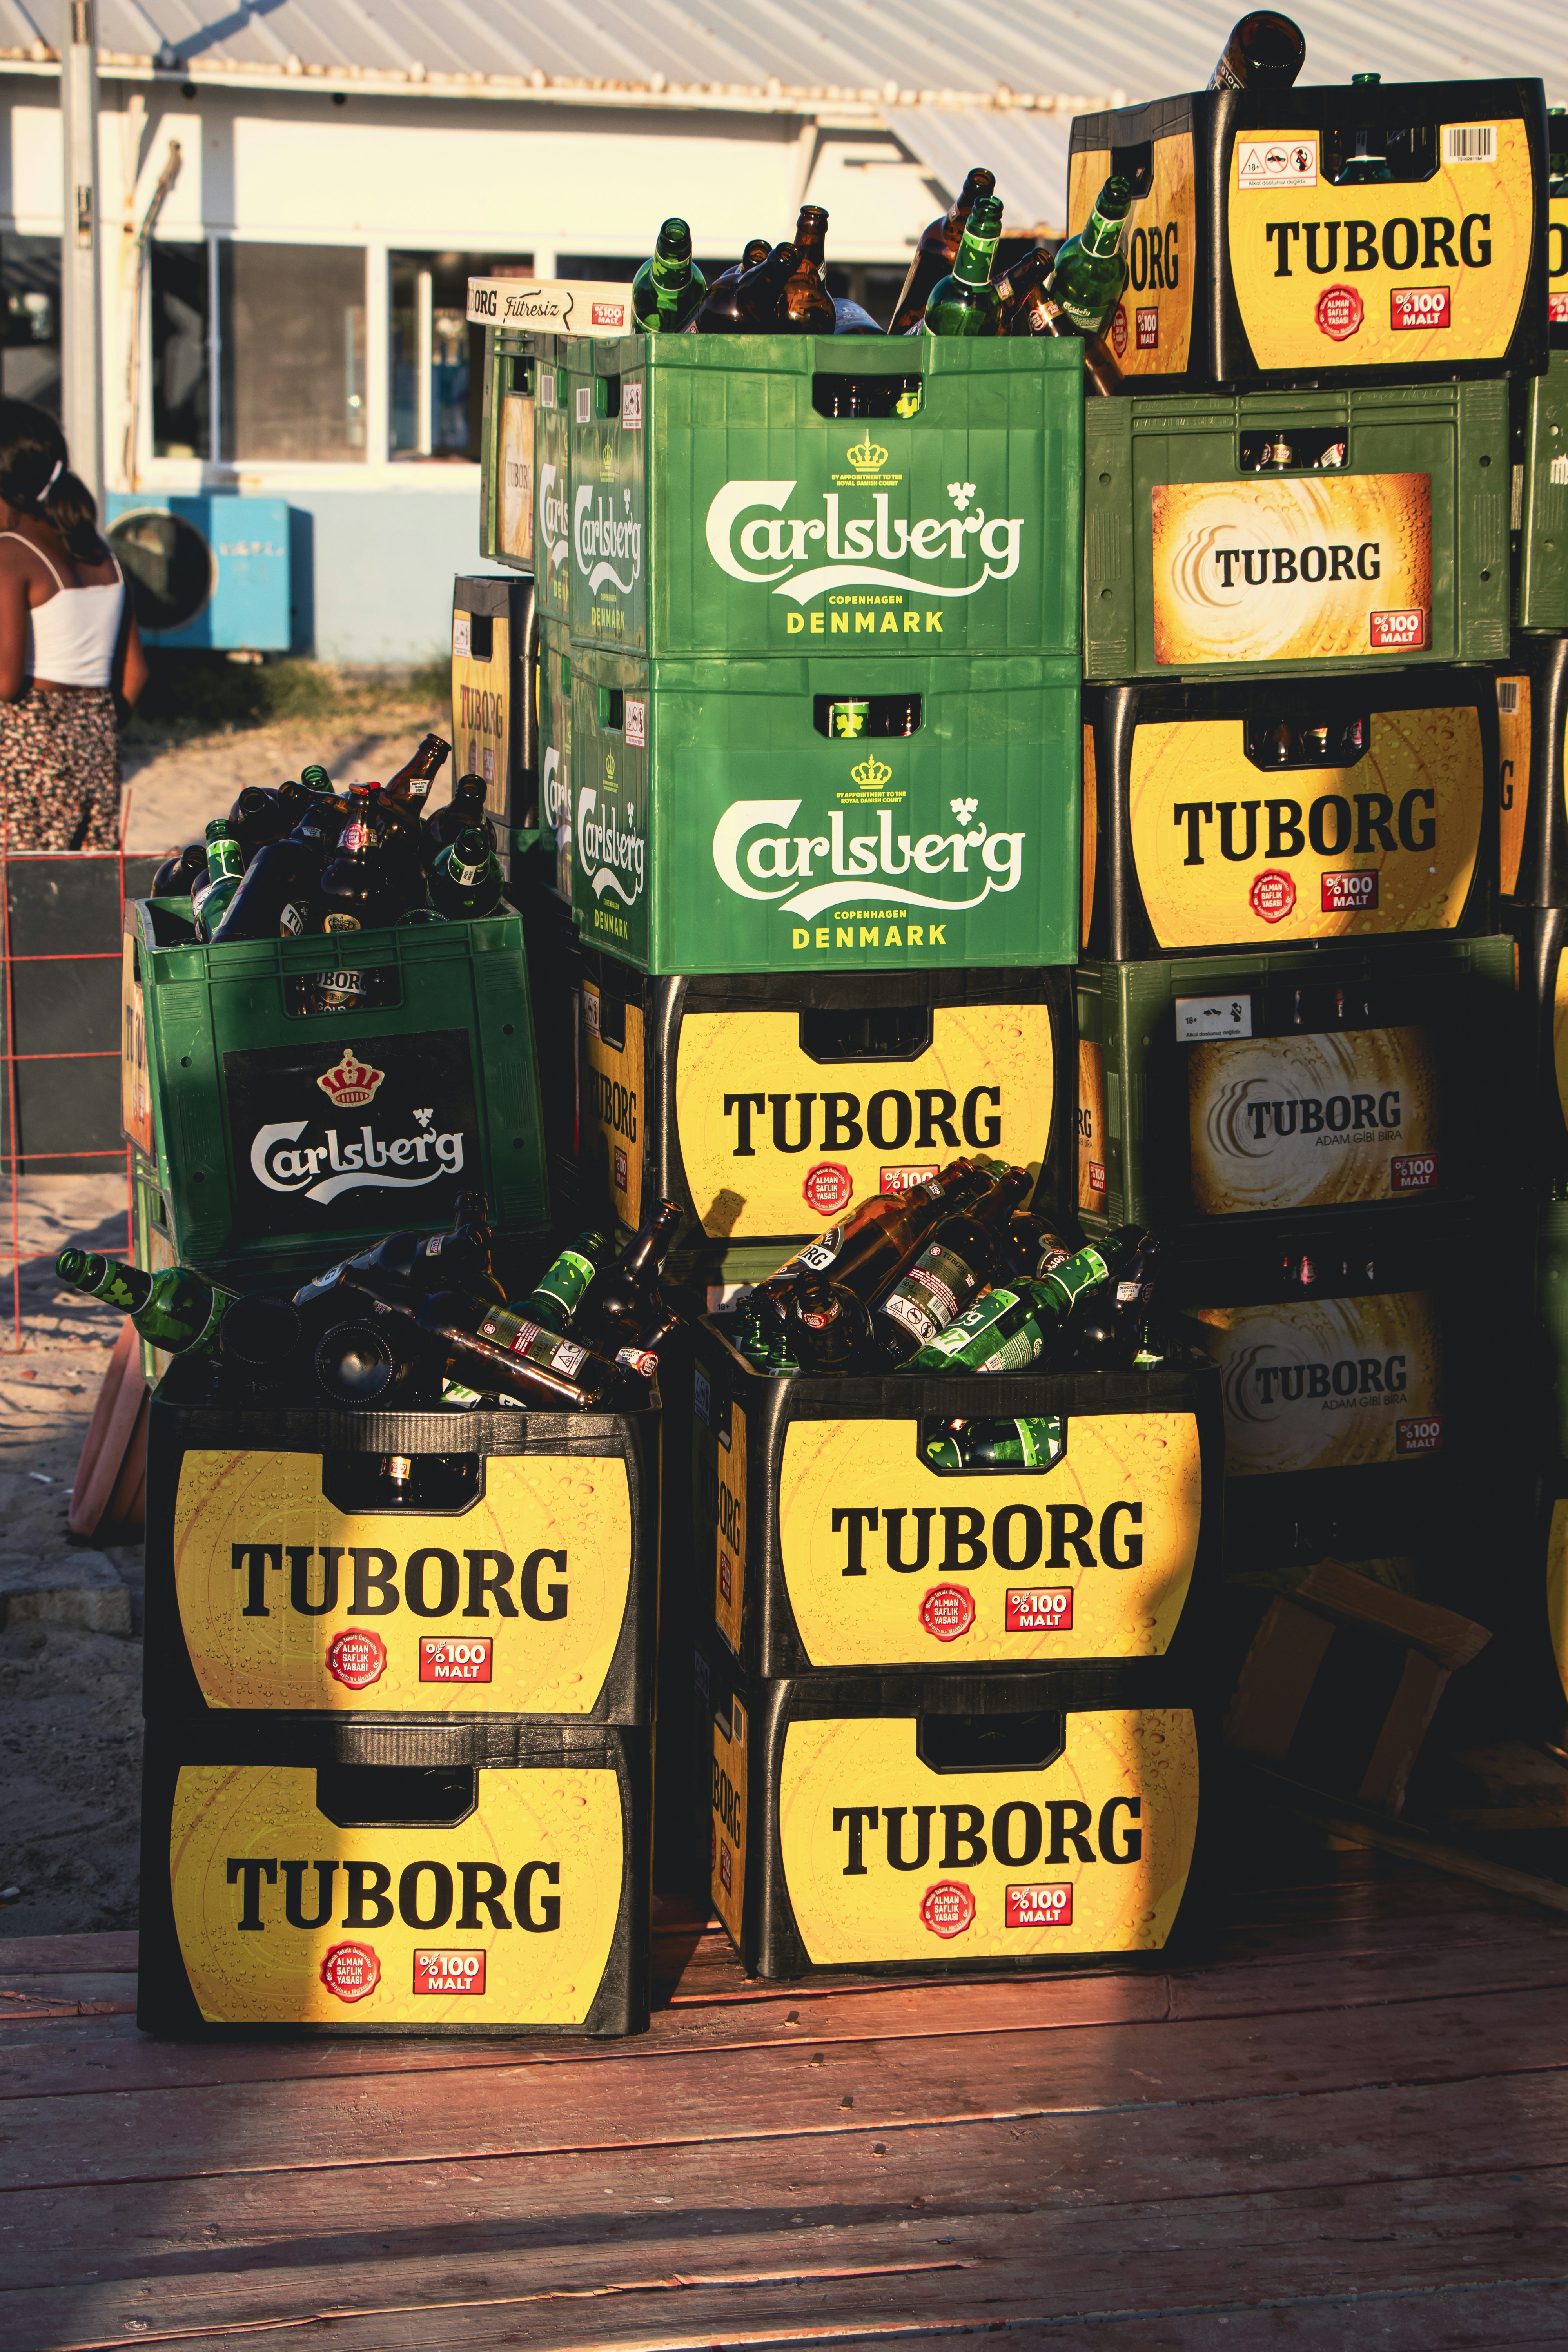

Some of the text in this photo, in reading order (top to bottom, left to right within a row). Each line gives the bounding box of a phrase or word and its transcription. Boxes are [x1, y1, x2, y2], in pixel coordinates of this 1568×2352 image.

[1248, 163, 1260, 171] 18+
[1266, 214, 1491, 277] TUBORG
[504, 290, 559, 318] Filtresiz
[1063, 301, 1091, 316] Carlsberg
[1327, 299, 1350, 308] ALMAN
[1395, 291, 1445, 314] %100
[594, 305, 622, 318] %100
[1327, 308, 1349, 316] SAFLIK
[598, 316, 619, 325] MALT
[1138, 312, 1156, 332] %100
[1328, 316, 1349, 325] YASASI
[1403, 313, 1441, 326] MALT
[1140, 333, 1155, 345] MALT
[574, 485, 641, 594] Carlsberg
[706, 481, 1024, 606] Carlsberg
[1215, 542, 1380, 587] TUBORG
[601, 593, 617, 602] COPENHAGEN
[829, 595, 903, 604] COPENHAGEN
[592, 606, 625, 630] DENMARK
[787, 611, 943, 633] DENMARK
[1374, 613, 1418, 633] %100
[1381, 632, 1415, 644] MALT
[460, 684, 503, 739] TUBORG
[1174, 788, 1435, 866] TUBORG
[577, 787, 644, 906] Carlsberg
[713, 799, 1025, 922] Carlsberg
[1261, 883, 1282, 891] ALMAN
[1326, 875, 1373, 896] %100
[1261, 891, 1282, 900] SAFLIK
[1334, 895, 1368, 907] MALT
[603, 898, 619, 911] COPENHAGEN
[1262, 899, 1282, 907] YASASI
[834, 909, 906, 920] COPENHAGEN
[594, 908, 628, 940] DENMARK
[793, 924, 947, 949] DENMARK
[588, 1064, 637, 1143] TUBORG
[724, 1085, 1001, 1156] TUBORG
[1248, 1091, 1401, 1139] TUBORG
[1315, 1129, 1403, 1147] ADAM GİBİ BİRA
[251, 1119, 463, 1205] Carlsberg
[1395, 1159, 1434, 1176] %100
[829, 1167, 847, 1185] Üniversitesi
[884, 1169, 934, 1190] %100
[1090, 1165, 1105, 1180] %100
[617, 1172, 625, 1188] MALT
[816, 1176, 838, 1184] ALMAN
[1092, 1179, 1103, 1189] MALT
[1401, 1174, 1431, 1187] MALT
[816, 1184, 838, 1192] SAFLIK
[816, 1192, 838, 1200] YASASI
[829, 1198, 843, 1209] Merkezi
[943, 1252, 968, 1274] TUBORG
[1047, 1255, 1065, 1272] %100
[582, 1335, 593, 1345] %100
[1256, 1356, 1406, 1404] TUBORG
[1322, 1392, 1408, 1411] ADAM GİBİ BİRA
[1400, 1422, 1441, 1439] %100
[1406, 1437, 1437, 1450] MALT
[832, 1501, 1143, 1577] TUBORG
[232, 1543, 568, 1621] TUBORG
[934, 1599, 959, 1607] ALMAN
[949, 1589, 968, 1608] Üniversitesi
[1012, 1591, 1067, 1615] %100
[934, 1608, 959, 1616] SAFLIK
[934, 1616, 958, 1624] YASASI
[1020, 1613, 1062, 1627] MALT
[948, 1623, 964, 1634] Merkezi
[333, 1641, 344, 1655] Münih
[358, 1634, 379, 1655] Üniversitesi
[342, 1644, 369, 1653] ALMAN
[342, 1653, 368, 1662] SAFLIK
[425, 1641, 486, 1665] %100
[343, 1662, 368, 1671] YASASI
[434, 1664, 479, 1678] MALT
[336, 1669, 375, 1682] Araştırma Merkezi
[833, 1797, 1142, 1875] TUBORG
[227, 1858, 561, 1933] TUBORG
[934, 1896, 959, 1904] ALMAN
[1012, 1887, 1067, 1911] %100
[934, 1905, 959, 1913] SAFLIK
[1020, 1909, 1062, 1923] MALT
[935, 1913, 958, 1922] YASASI
[327, 1954, 338, 1968] Münih
[352, 1947, 373, 1968] Üniversitesi
[336, 1957, 363, 1966] ALMAN
[419, 1953, 480, 1976] %100
[336, 1967, 363, 1975] SAFLIK
[337, 1976, 362, 1985] YASASI
[428, 1977, 472, 1991] MALT
[330, 1982, 370, 1995] Araştırma Merkezi
